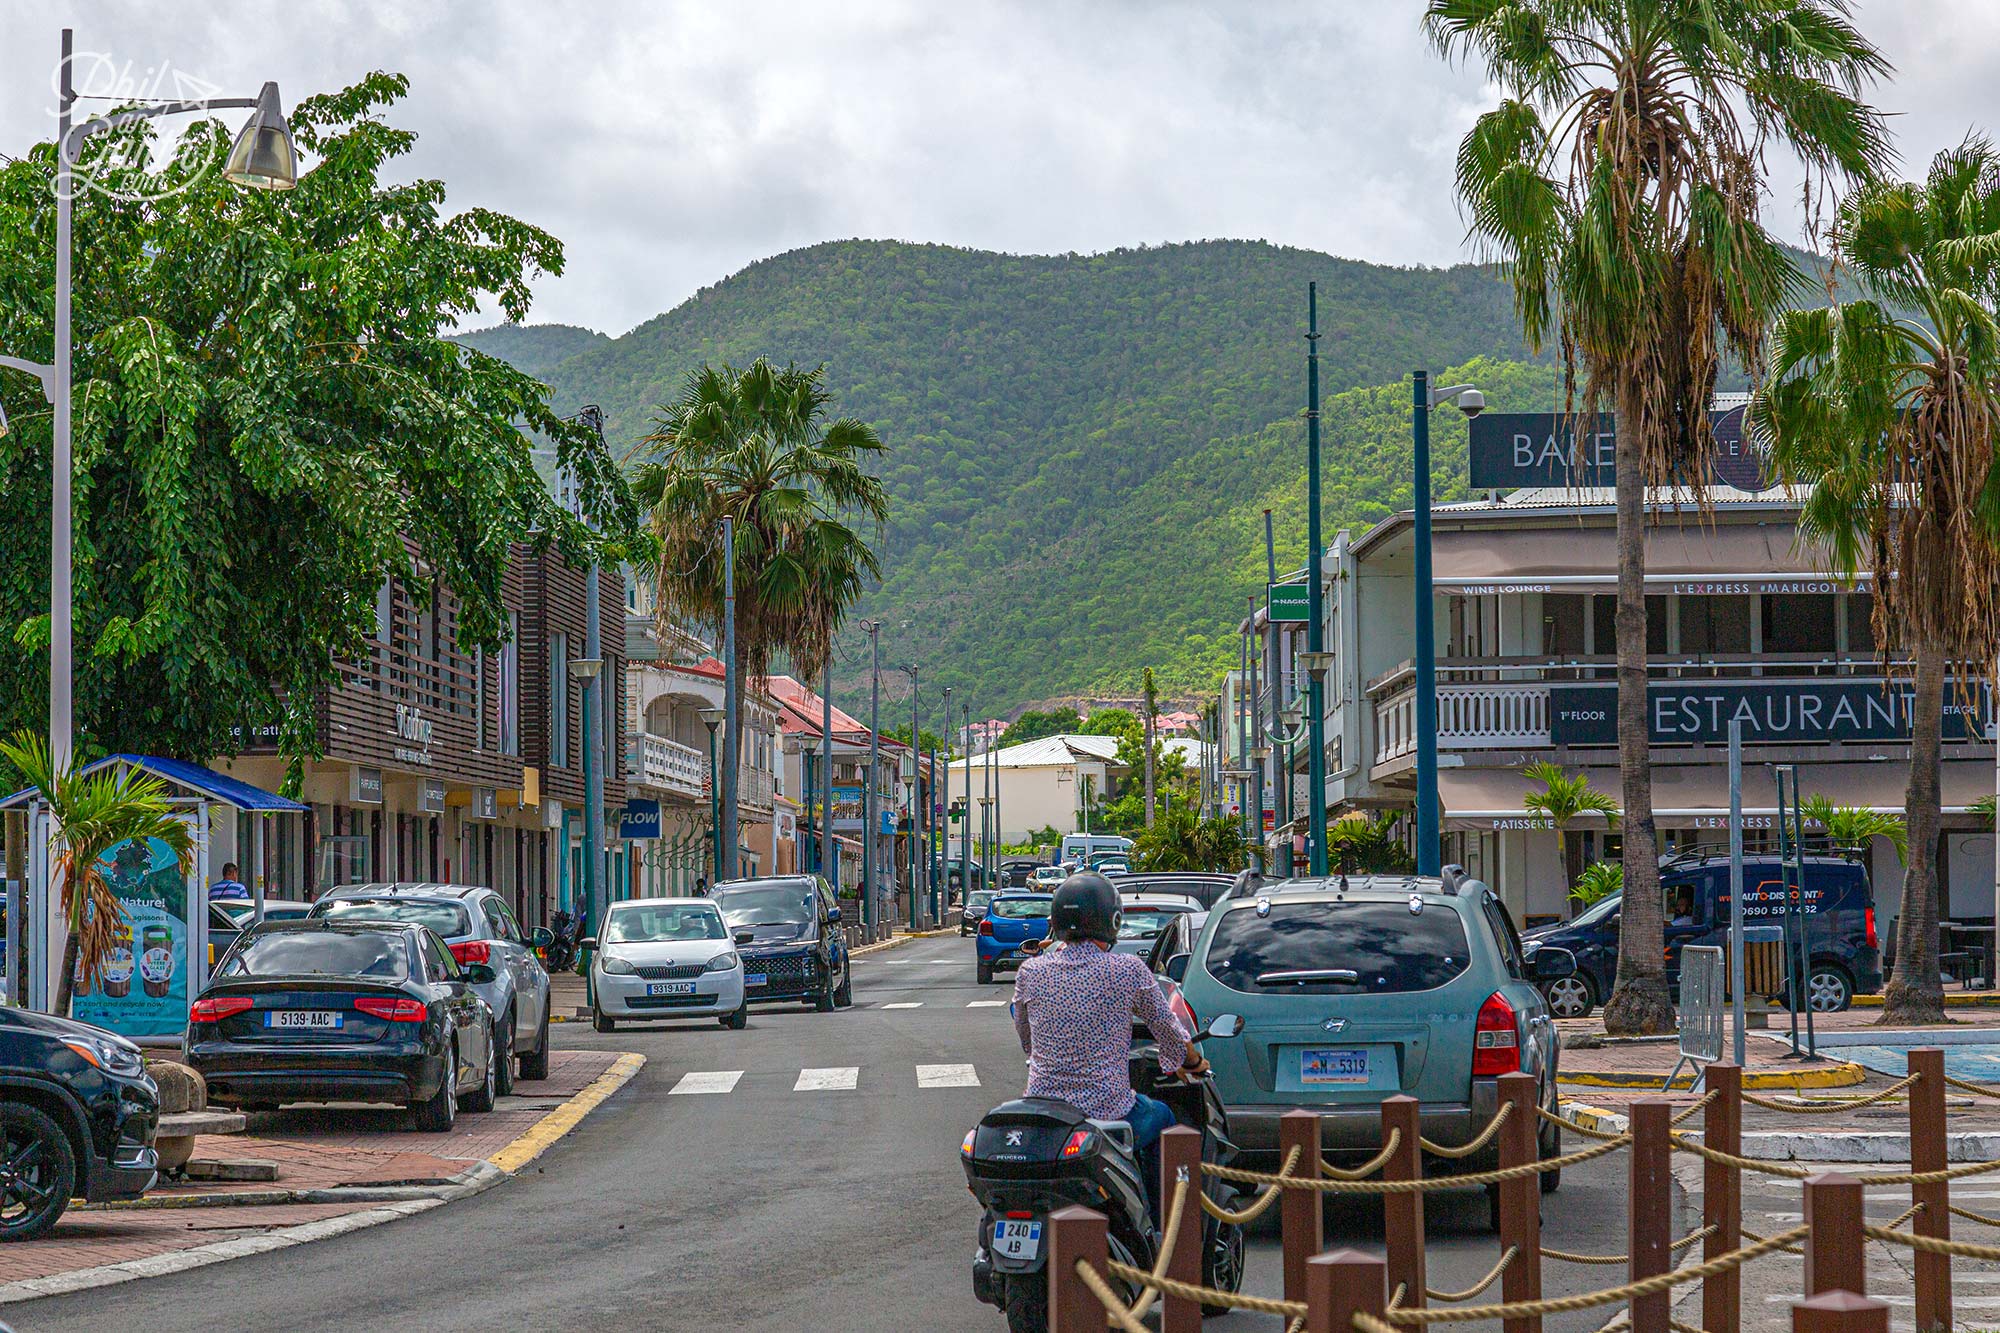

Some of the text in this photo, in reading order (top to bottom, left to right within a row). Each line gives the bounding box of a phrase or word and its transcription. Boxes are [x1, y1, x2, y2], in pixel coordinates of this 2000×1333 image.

[1463, 584, 1551, 594] WINE LOUNGE
[1674, 584, 1749, 594] L'EXPRESS
[1571, 711, 1606, 721] FLOOR
[1655, 693, 1917, 734] ESTAURANT
[620, 812, 660, 825] FLOW
[1695, 817, 1772, 828] L'EXRESS
[119, 897, 166, 908] Nature!
[653, 984, 690, 993] 9319 AAC
[1339, 1059, 1366, 1074] 5319
[1007, 1224, 1029, 1238] 240
